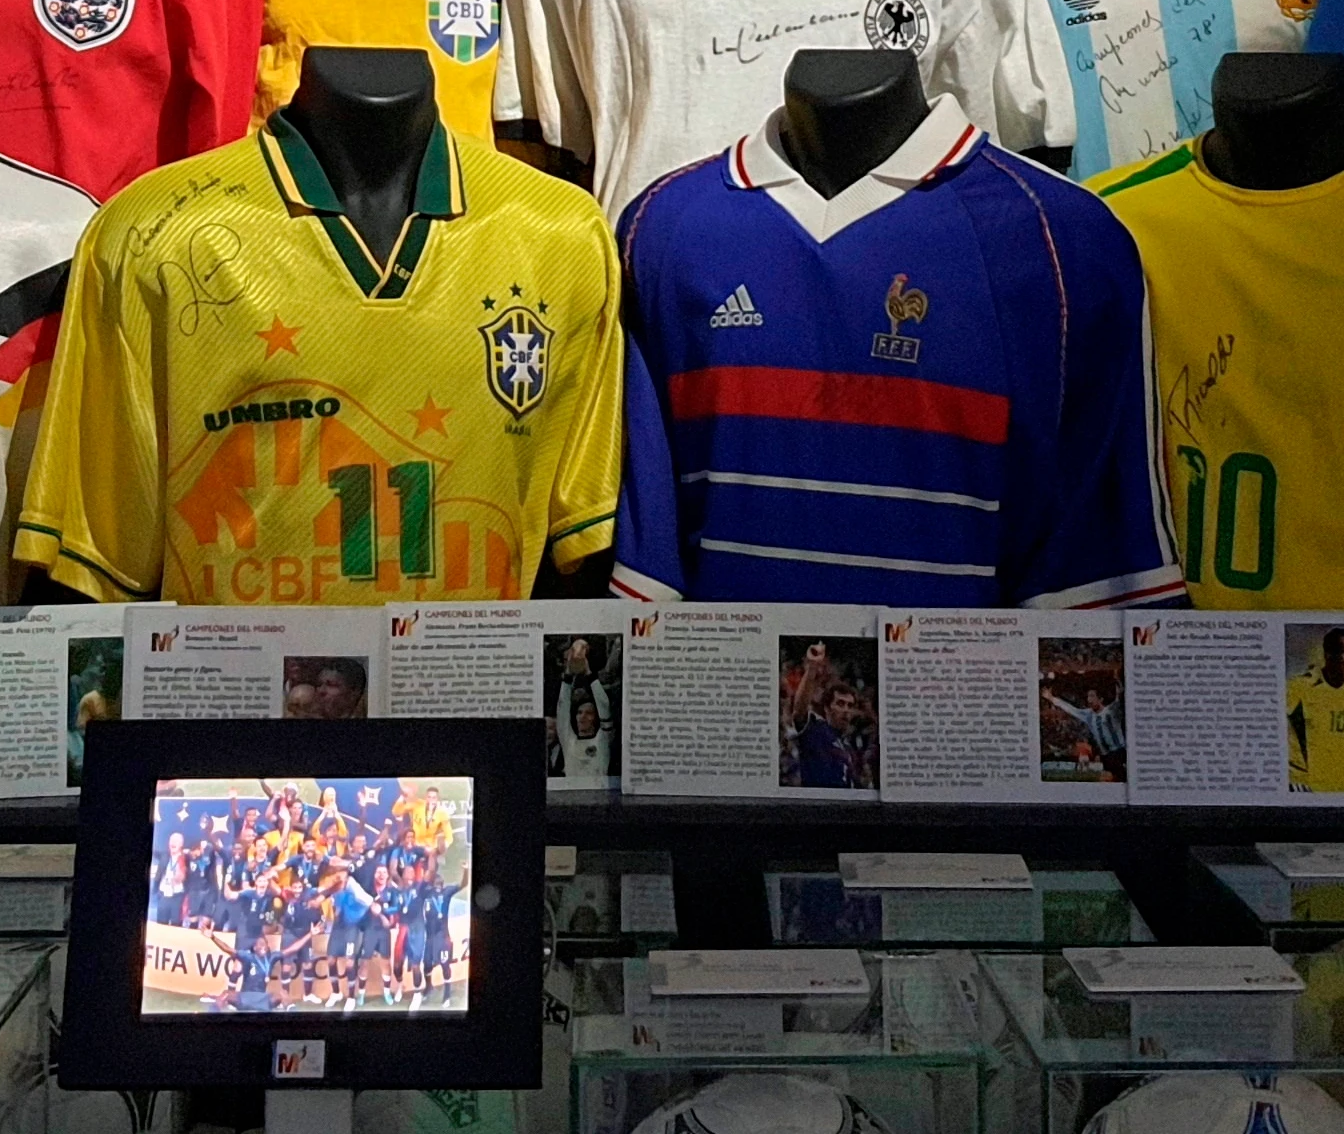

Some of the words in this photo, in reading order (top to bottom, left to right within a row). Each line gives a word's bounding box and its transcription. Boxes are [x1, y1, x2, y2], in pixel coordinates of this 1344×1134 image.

[447, 1, 485, 19] CBD
[1066, 12, 1107, 26] adidas
[710, 312, 764, 329] adidas
[509, 350, 533, 364] CBF
[203, 396, 342, 433] UMBRO
[327, 459, 436, 583] 11
[1176, 444, 1278, 592] 10
[19, 614, 52, 624] MUNDO
[425, 609, 473, 619] CAMPEONES
[474, 609, 488, 618] DEL
[490, 608, 522, 618] MUNDO
[664, 612, 713, 621] CAMPEONES
[715, 613, 729, 622] DEL
[730, 613, 763, 623] MUNDO
[186, 624, 235, 633] CAMPEONES
[237, 624, 251, 633] DEL
[253, 624, 286, 634] MUNDO
[918, 617, 968, 626] CAMPEONES
[969, 617, 983, 626] DEL
[985, 617, 1018, 627] MUNDO
[1166, 621, 1216, 630] CAMPEONES
[1218, 621, 1233, 630] DEL
[1234, 621, 1268, 630] MUNDO
[145, 943, 189, 976] FIFA
